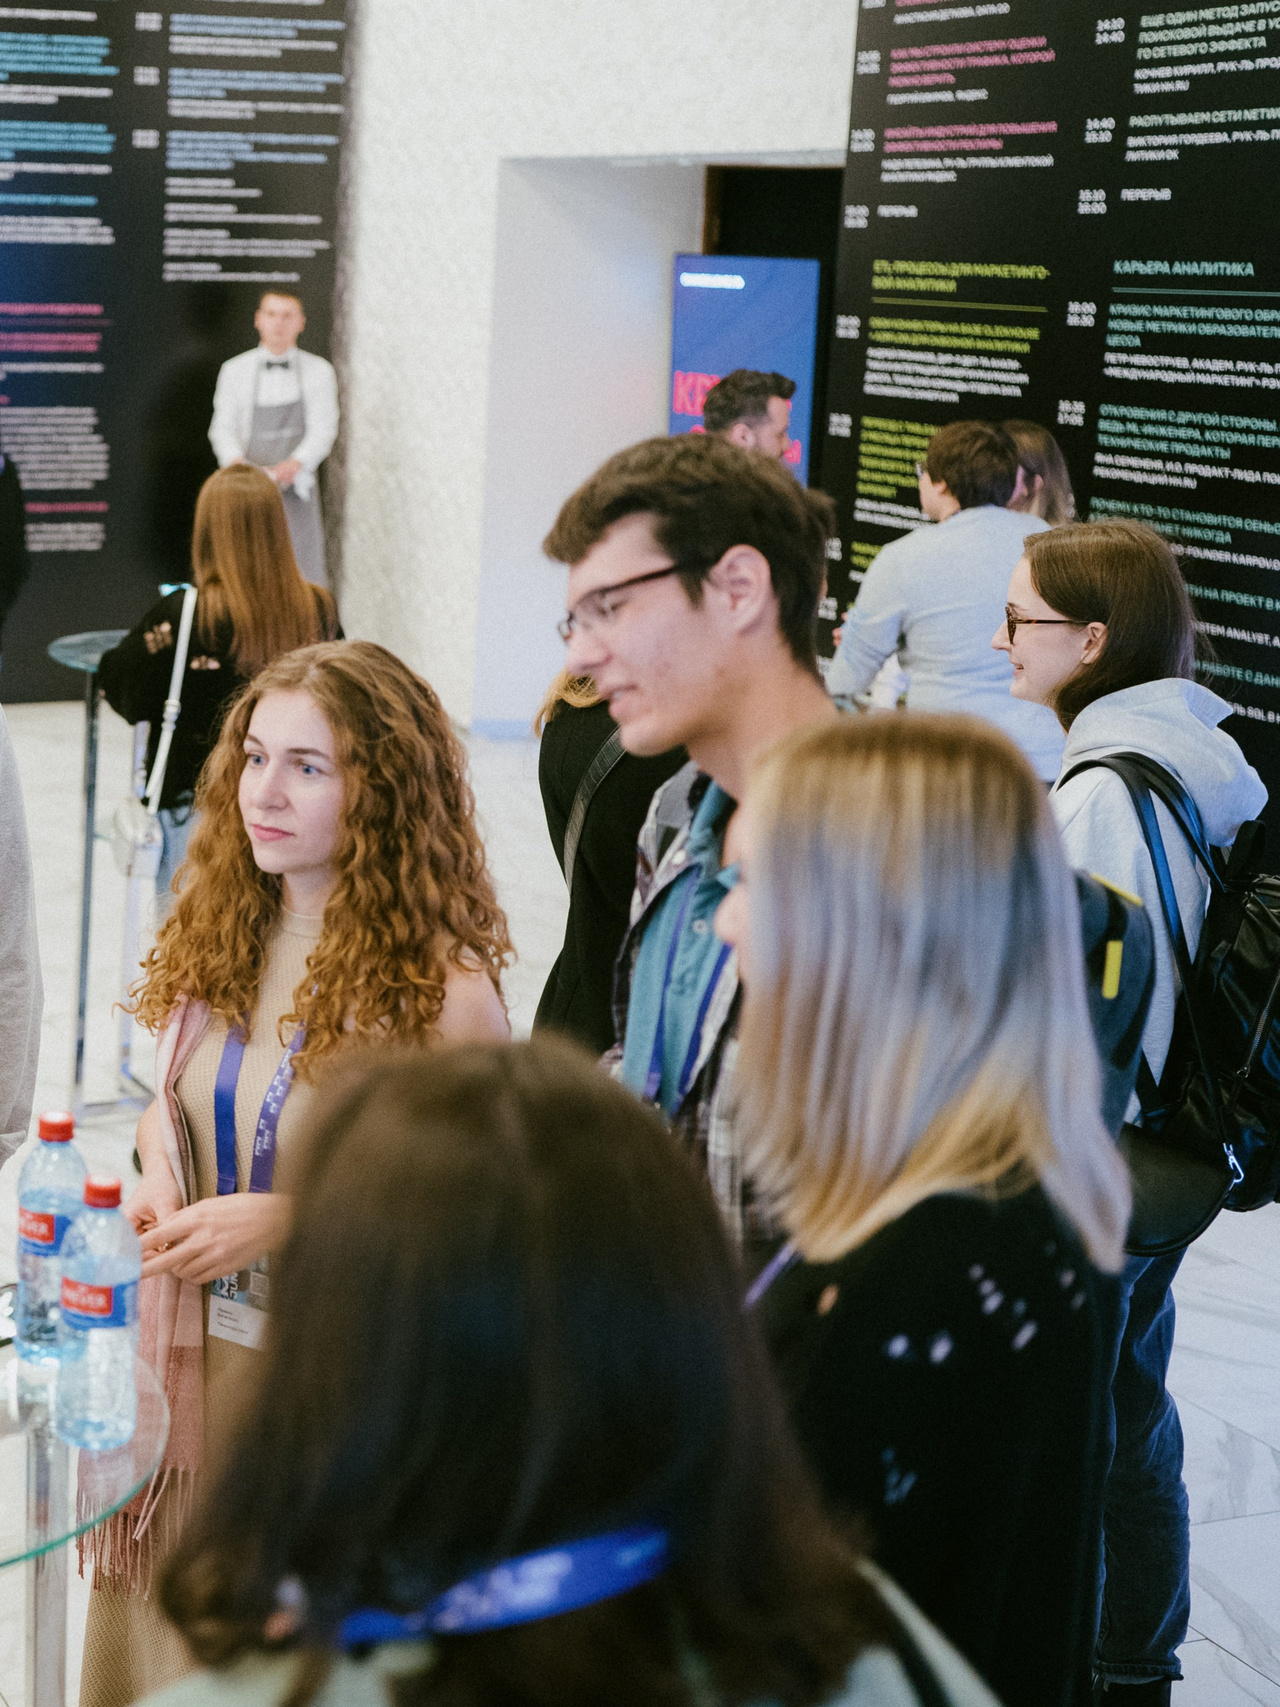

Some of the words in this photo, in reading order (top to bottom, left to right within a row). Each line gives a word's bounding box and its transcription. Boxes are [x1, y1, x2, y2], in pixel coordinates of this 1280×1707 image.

[1166, 10, 1198, 25] ОДИН
[1199, 5, 1239, 21] МЕТОД
[1138, 24, 1207, 44] ПОИСКОВОЙ
[1208, 20, 1256, 36] ВЫДАЧЕ
[1152, 42, 1208, 59] СЕТЕВОГО
[1209, 36, 1267, 53] ЭФФЕКТА
[1212, 109, 1242, 123] СЕТИ
[1114, 260, 1170, 275] КАРЬЕРА
[1172, 261, 1254, 276] АНАЛИТИКА
[1152, 305, 1253, 321] МАРКЕТИНГОВОГО
[1146, 320, 1197, 335] МЕТРИКИ
